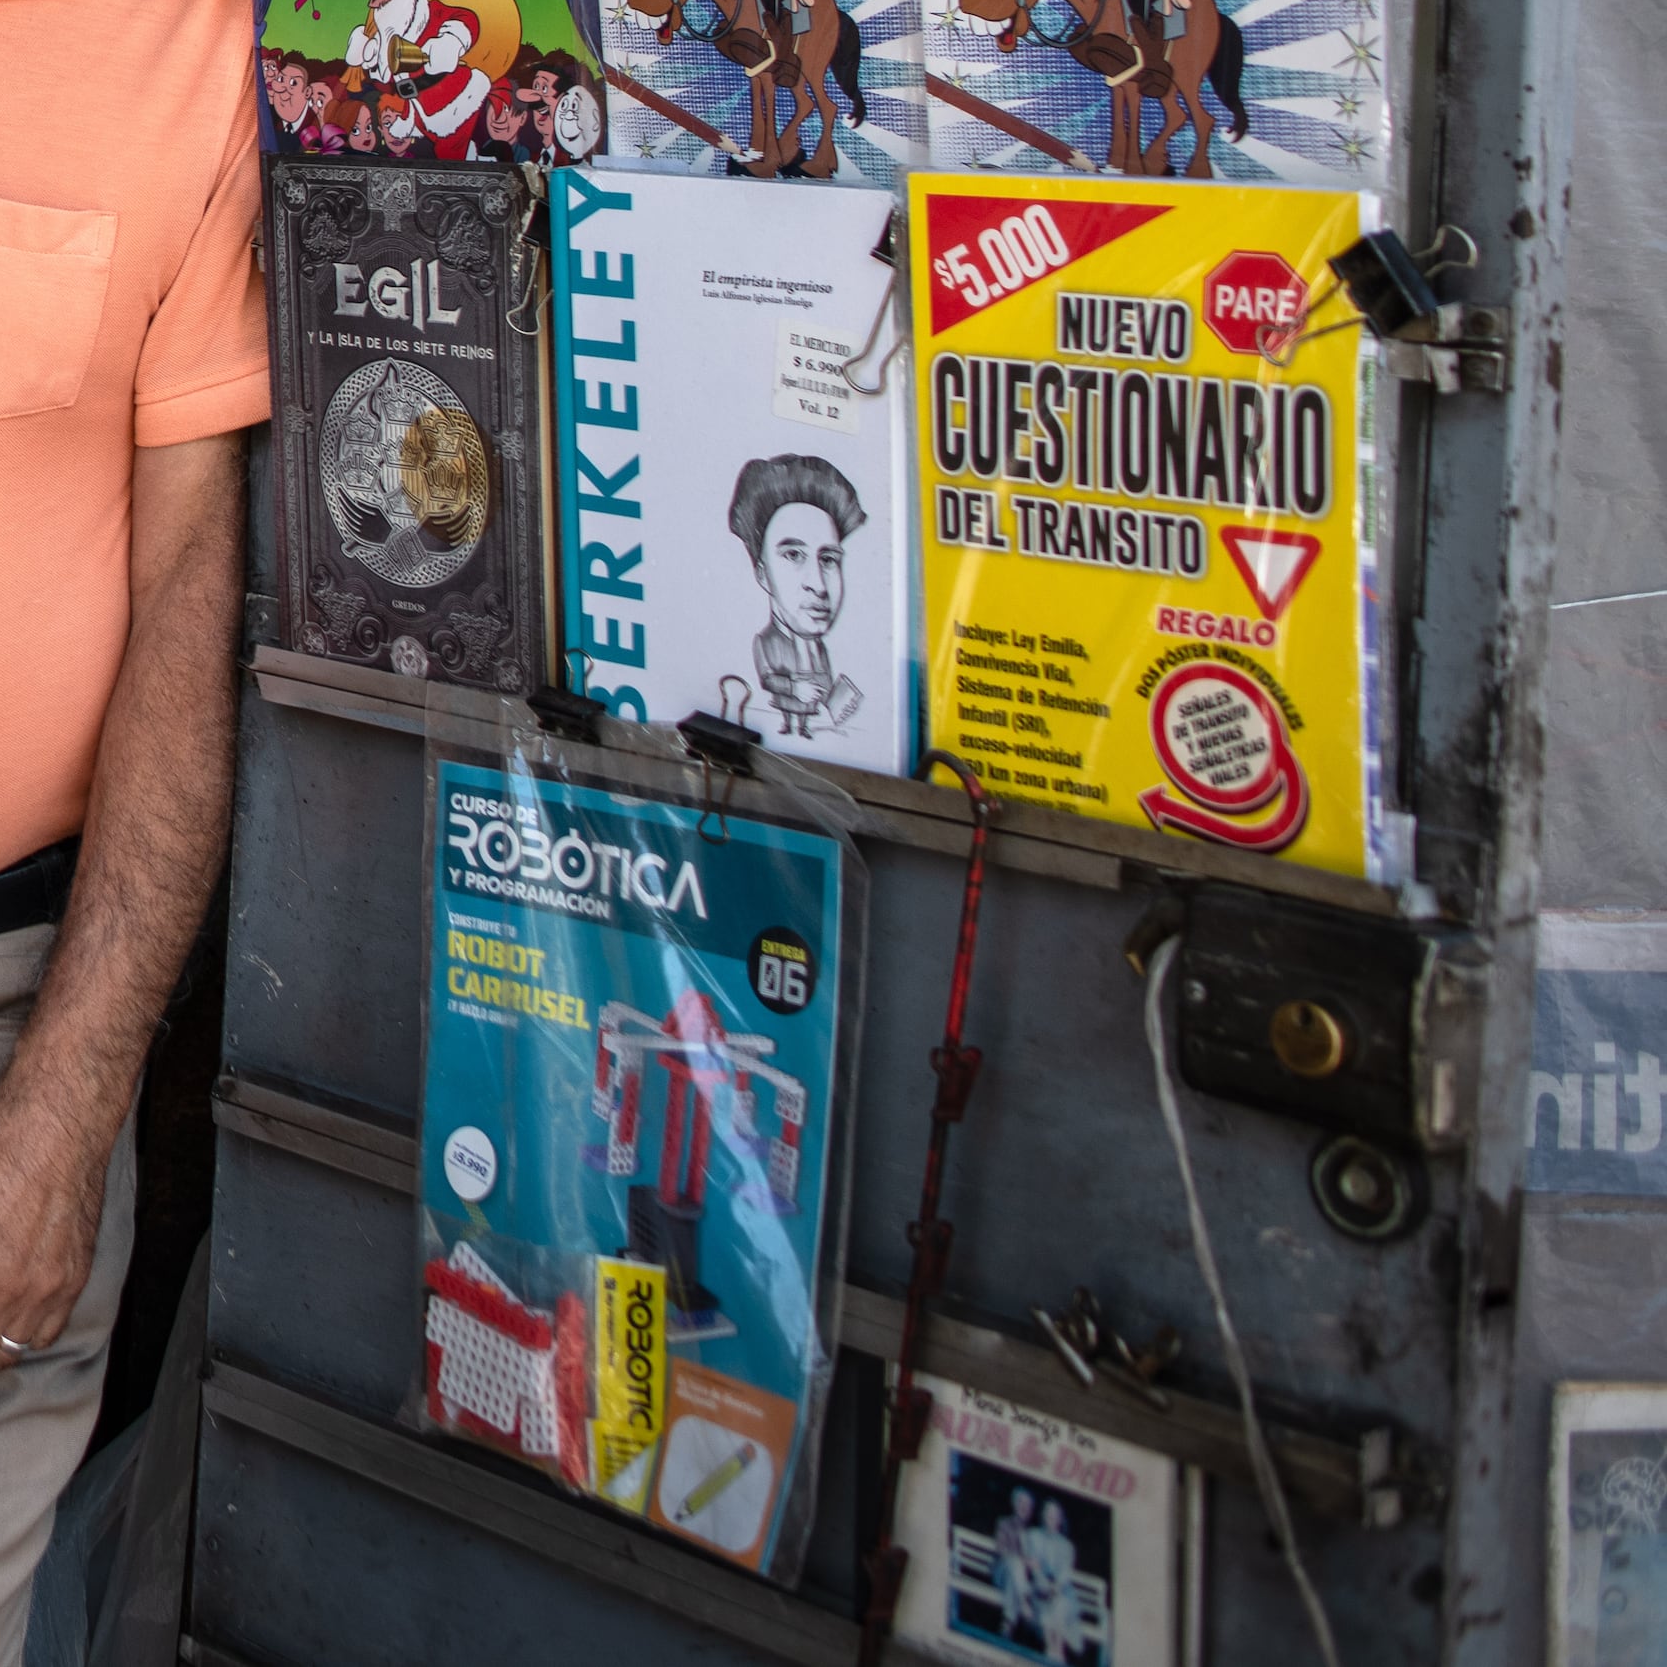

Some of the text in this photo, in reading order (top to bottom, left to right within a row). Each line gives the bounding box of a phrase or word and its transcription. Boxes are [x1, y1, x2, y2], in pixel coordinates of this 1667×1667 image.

[933, 202, 1071, 308] $5.000
[333, 260, 465, 332] EGIL
[1213, 283, 1300, 323] PARE
[307, 331, 495, 361] Y LA ISLA DE LOS SIETE REINOS
[1057, 291, 1191, 363] NUEVO
[805, 358, 843, 378] 6.990
[567, 167, 648, 724] BERKELEY
[932, 354, 1331, 516] CUESTIONARIO
[936, 486, 1206, 578] DEL TRANSITO
[391, 598, 426, 614] GREDOS
[1157, 606, 1276, 647] REGALO
[450, 792, 539, 825] CURSO DE
[448, 866, 612, 920] Y PROGRAMACIÓN
[449, 812, 708, 922] ROBÓTICA
[447, 929, 546, 979] ROBOT
[761, 939, 807, 965] ENTREGA
[447, 965, 591, 1032] CARRUSEL
[758, 956, 809, 1007] 06
